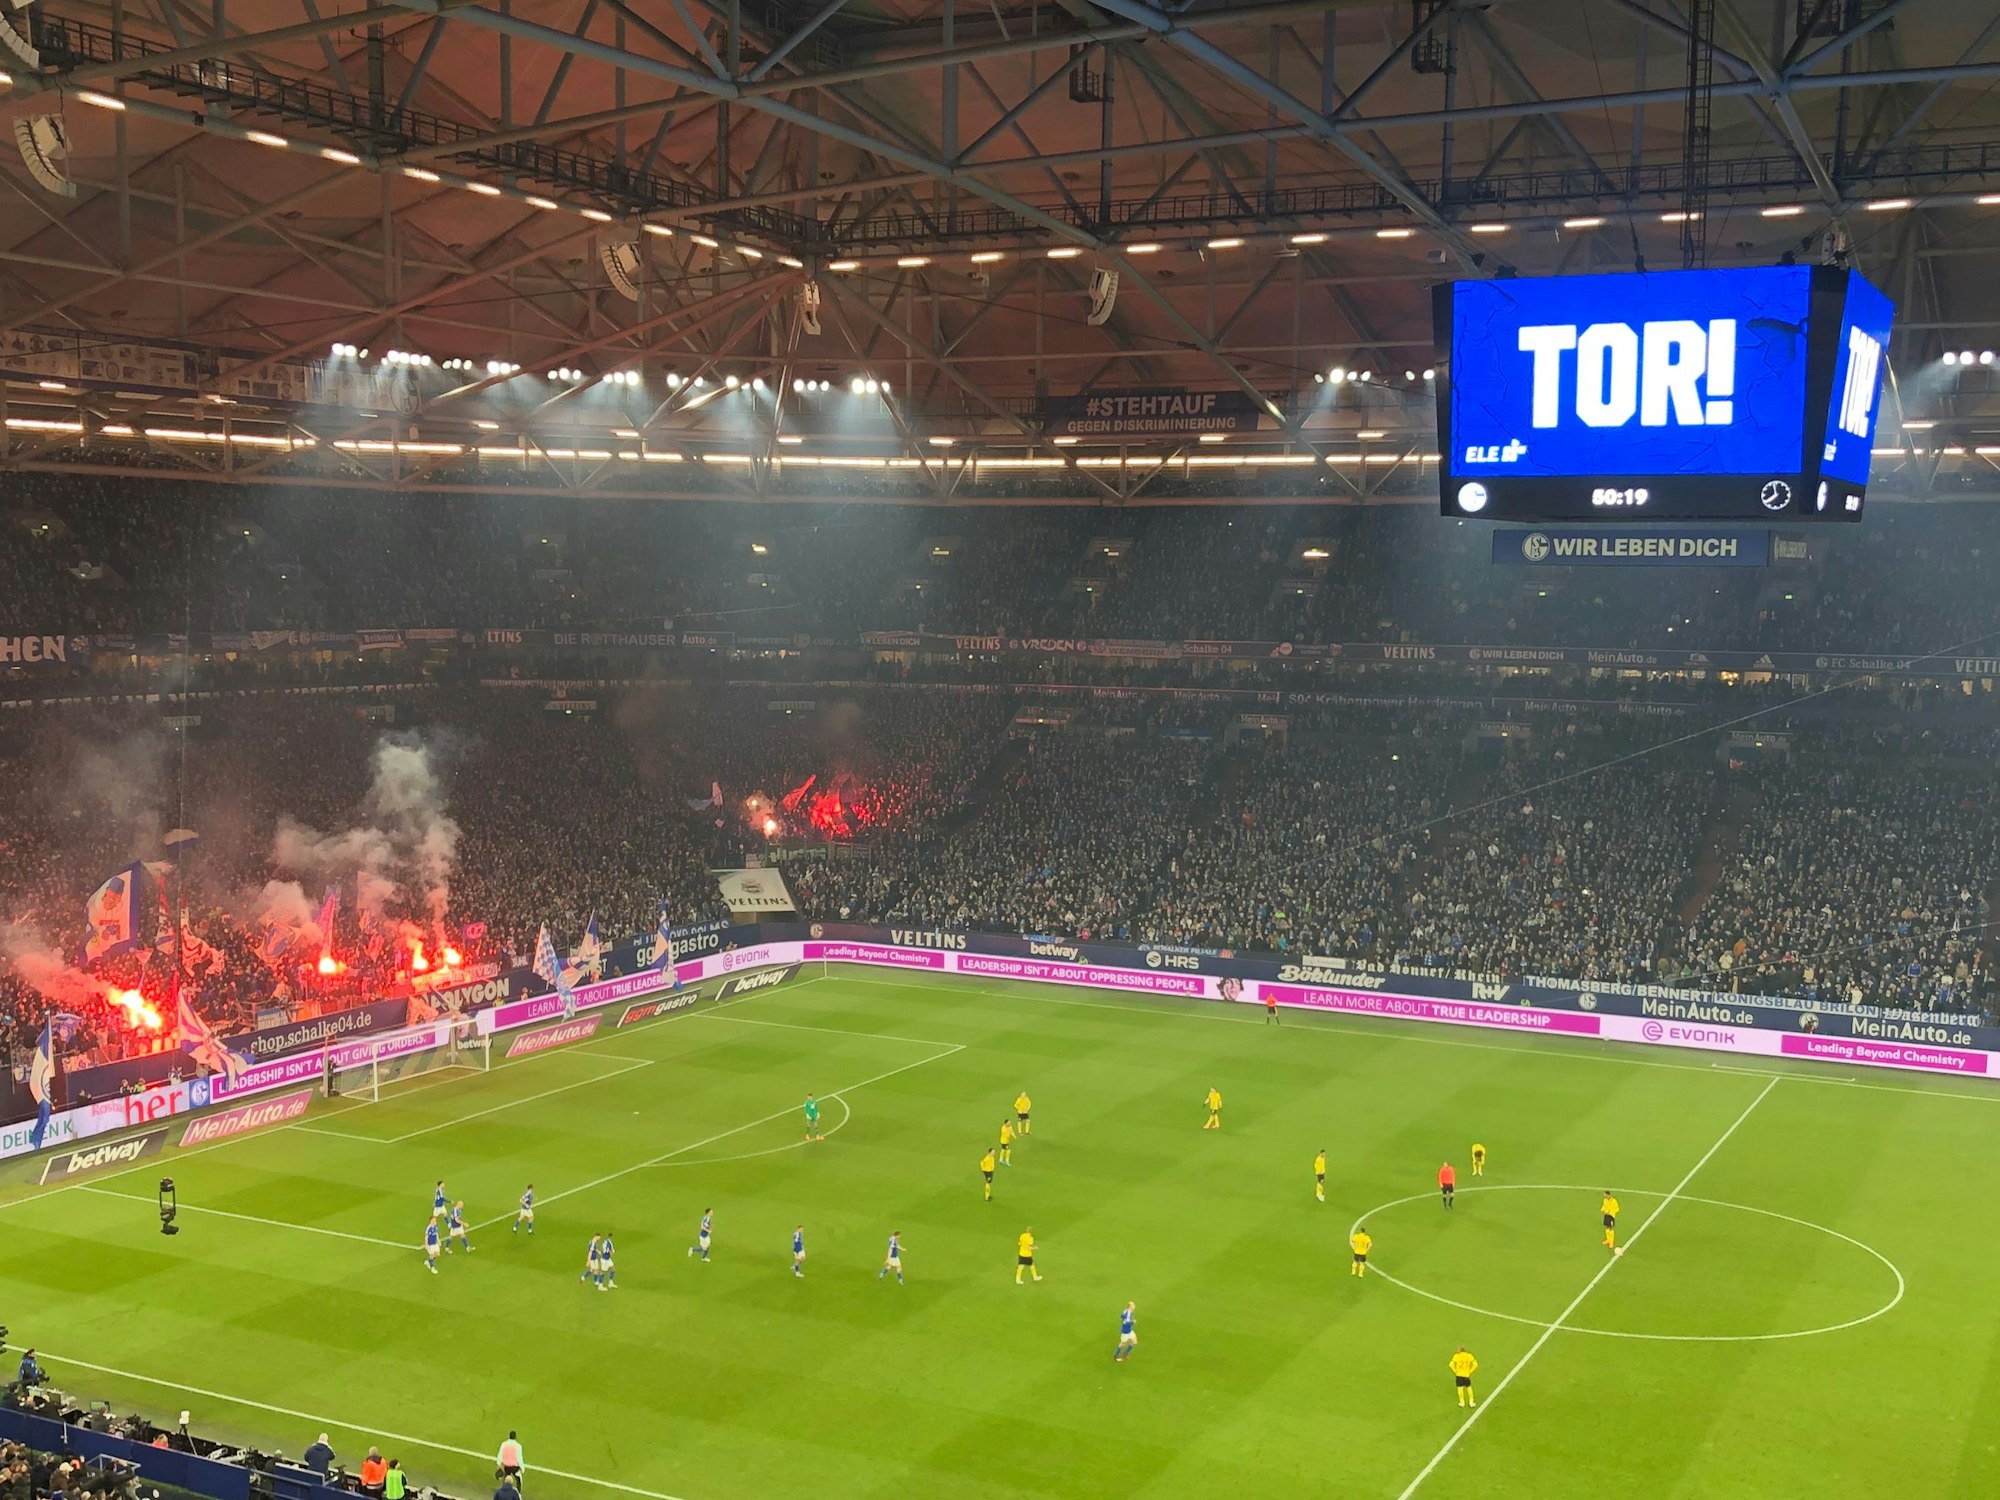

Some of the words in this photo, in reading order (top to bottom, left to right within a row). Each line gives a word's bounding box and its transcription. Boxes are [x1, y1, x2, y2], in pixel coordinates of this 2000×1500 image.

[1518, 318, 1737, 428] TOR!
[1086, 394, 1217, 416] #STEHTAUF
[1068, 420, 1111, 433] GEGEN
[1114, 417, 1236, 432] DISKRIMINIERUNG
[1553, 538, 1598, 556] WIR
[1601, 538, 1674, 557] LEBEN
[1679, 538, 1737, 557] DICH
[487, 630, 523, 644] LTINS
[554, 633, 578, 645] DIE
[956, 637, 1001, 650] VELTINS
[1021, 639, 1075, 652] VREDEN
[0, 634, 66, 662] HEN
[1183, 643, 1219, 654] Schalke
[1220, 644, 1233, 654] 04
[1383, 646, 1436, 660] VELTINS
[1482, 649, 1503, 660] WIR
[1503, 650, 1538, 660] LEBEN
[1538, 650, 1564, 661] DICH
[1588, 651, 1658, 665] MeinAuto.de
[1831, 658, 1846, 668] FC
[1849, 658, 1894, 670] Schalke
[1955, 659, 2000, 673] VELTI
[728, 897, 788, 906] VELTINS
[890, 929, 967, 950] VELTINS
[636, 933, 719, 968] gggastro
[735, 949, 770, 965] EVONIK
[823, 946, 857, 959] Leading
[858, 948, 888, 961] Beyond
[889, 951, 931, 965] Chemistry
[1030, 942, 1079, 960] betway
[1164, 954, 1200, 970] HRS
[734, 967, 790, 994] betway
[962, 958, 1023, 974] LEADERSHIP
[1024, 963, 1051, 977] ISN'T
[1051, 967, 1088, 981] ABOUT
[1089, 971, 1154, 990] OPPRESSING
[1155, 977, 1198, 992] PEOPLE.
[1277, 964, 1386, 990] Böklunder
[528, 1000, 557, 1018] LEARN
[557, 993, 582, 1011] ME
[582, 986, 610, 1005] ABOUT
[611, 982, 632, 997] TRUE
[633, 971, 678, 991] LEADER
[1527, 975, 1712, 1003] THOMASBERG/BENNERT
[624, 994, 699, 1024] ggmgastro
[1303, 991, 1344, 1006] LEARN
[1345, 995, 1383, 1011] MORE
[1384, 998, 1429, 1015] ABOUT
[1431, 1004, 1467, 1019] TRUE
[1468, 1007, 1551, 1027] LEADERSHIP
[1642, 997, 1754, 1025] MeinAuto.de
[1819, 1002, 1877, 1016] BRILON
[251, 1011, 372, 1054] shop.schalke04.de
[514, 1022, 595, 1053] MeinAuto.de
[1669, 1027, 1736, 1045] EVONIK
[1852, 1016, 1973, 1045] MeinAuto.de
[219, 1067, 285, 1095] LADERSHIP
[286, 1059, 313, 1077] ISN'T
[314, 1049, 350, 1070] AOUT
[352, 1042, 386, 1061] GIVIG
[387, 1033, 427, 1052] ORDERS.
[1807, 1041, 1854, 1058] Leading
[1856, 1046, 1901, 1062] Beyond
[1903, 1050, 1966, 1068] Chemistry
[188, 1099, 305, 1143] MeinAuto.de
[3, 1120, 60, 1150] DEIEN
[67, 1137, 149, 1175] betway
